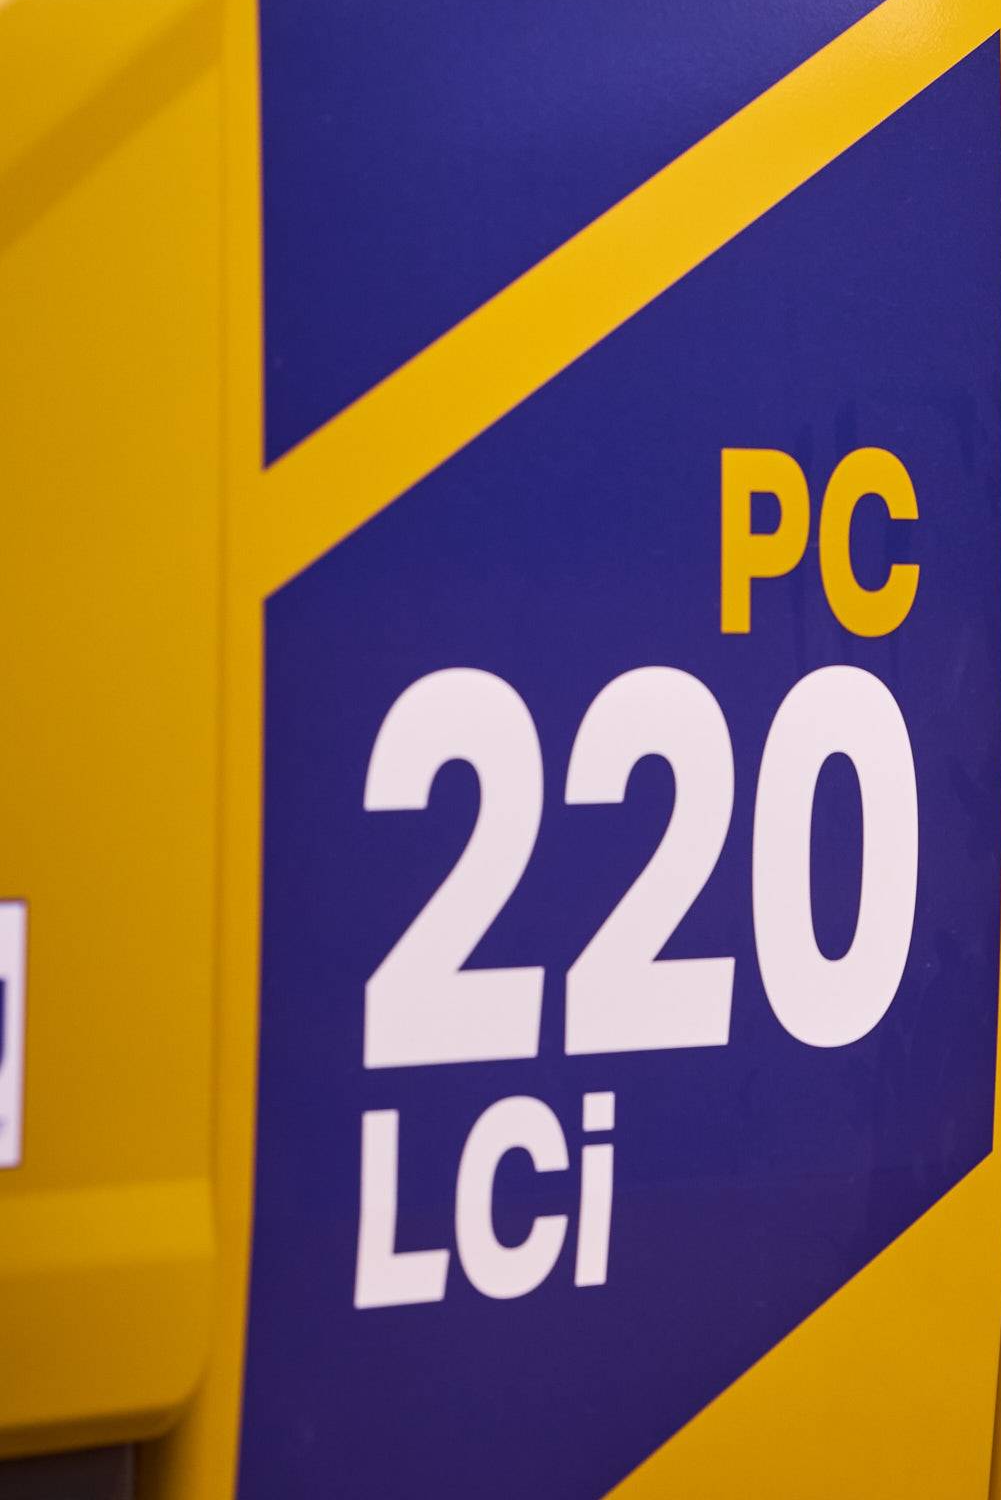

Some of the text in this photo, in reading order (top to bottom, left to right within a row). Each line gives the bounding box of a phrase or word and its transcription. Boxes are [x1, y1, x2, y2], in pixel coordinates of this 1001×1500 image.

[721, 447, 920, 637] PC
[364, 665, 919, 1069] 220
[354, 1092, 615, 1309] LCi
